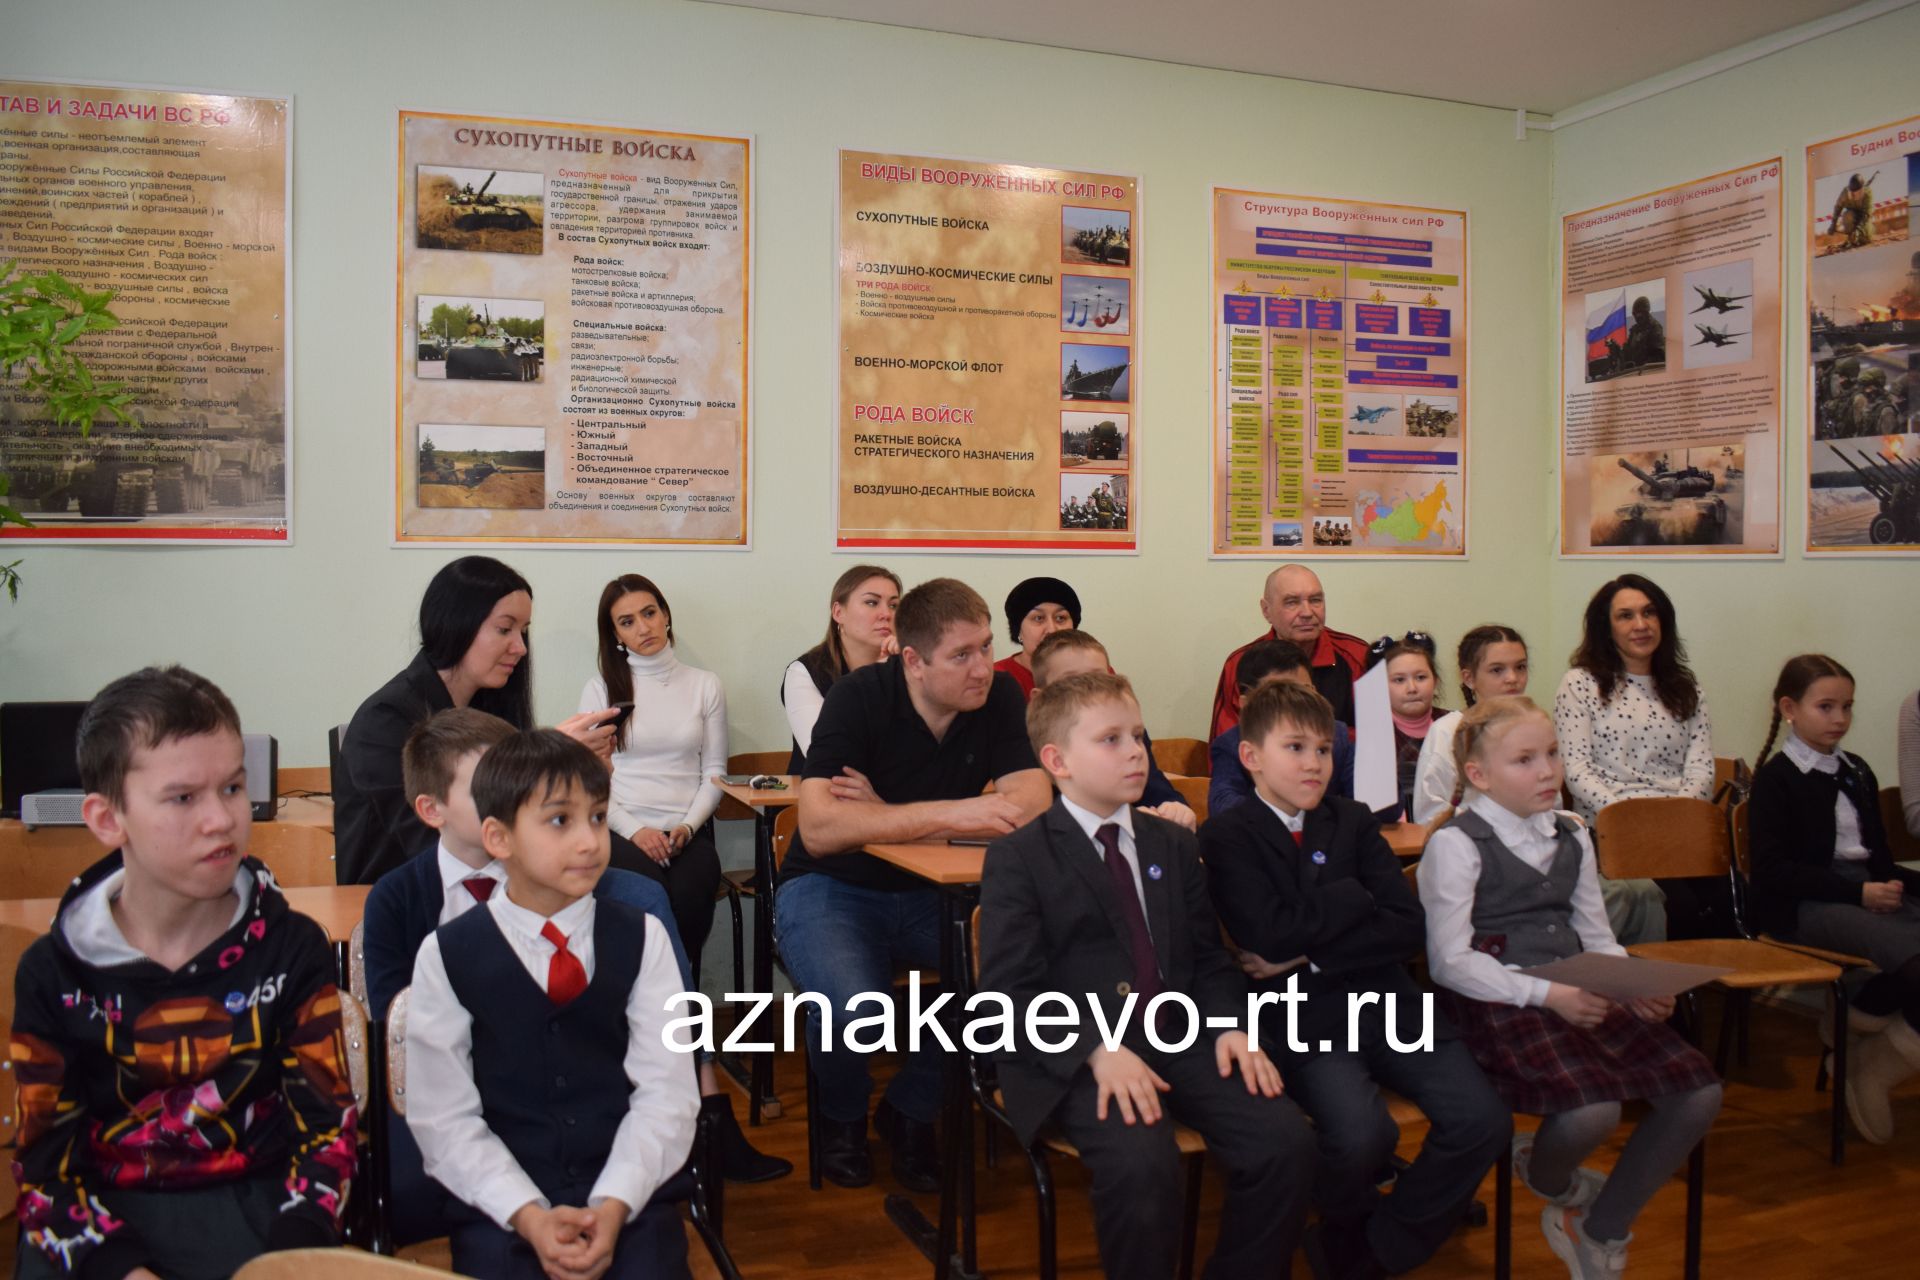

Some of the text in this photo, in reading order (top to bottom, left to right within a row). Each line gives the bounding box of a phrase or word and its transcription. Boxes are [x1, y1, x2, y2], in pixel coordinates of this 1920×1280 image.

[47, 99, 61, 114] И
[69, 100, 157, 120] ЗАДАЧИ
[165, 106, 191, 122] ВС
[200, 108, 230, 125] РФ
[41, 131, 68, 139] силы
[79, 133, 159, 144] неотъемлемый
[163, 138, 207, 147] элемент
[454, 127, 696, 161] СУХОПУТНЫЕ ВОЙСКА
[1850, 137, 1893, 156] Будни
[69, 166, 225, 181] Силы Российской Федерации
[559, 169, 607, 179] Сухопутные
[610, 173, 636, 181] войска
[664, 177, 716, 187] Вооруженных
[720, 181, 737, 189] Сил,
[32, 177, 74, 185] органов
[78, 179, 126, 187] военного
[861, 162, 915, 182] ВИДЫ
[1062, 181, 1095, 197] СИЛ
[1101, 185, 1124, 200] РФ
[551, 180, 630, 191] предназначенный
[693, 191, 737, 199] прикрытия
[92, 191, 188, 202] частей кораблей
[551, 191, 618, 201] государственной
[663, 199, 705, 207] отражения
[710, 202, 737, 210] ударов
[1568, 168, 1777, 232] Предназначение Вооруженных Сил РФ
[551, 202, 737, 220] агрессора, удержания занимаемой
[1244, 201, 1444, 228] Структура Вооруженных сил РФ
[551, 213, 600, 222] территории,
[607, 216, 644, 225] разгрома
[650, 219, 698, 228] группировок
[856, 211, 989, 230] СУХОПУТНЫЕ ВОЙСКА
[26, 221, 213, 238] Сил Российской Федерации входят
[551, 223, 694, 238] овладения территорией противника.
[13, 232, 66, 243] Воздушно
[77, 237, 144, 246] космические
[184, 240, 222, 249] Военно
[233, 244, 274, 252] морской
[598, 235, 649, 246] Сухопутных
[652, 239, 676, 247] войск
[679, 242, 709, 250] входят:
[8, 245, 217, 260] видами Вооружённых Сил Рода войск
[573, 255, 624, 265] Рода войск:
[57, 268, 110, 279] Воздушно
[120, 273, 186, 281] космических
[571, 268, 668, 279] мотострелковые войска;
[856, 262, 1052, 285] ВОЗДУШНО-КОСМИЧЕСКИЕ СИЛЫ
[611, 280, 640, 288] войска;
[856, 280, 872, 288] ТРИ
[875, 281, 899, 291] РОДА
[164, 297, 230, 305] космические
[611, 290, 638, 298] войска
[647, 293, 695, 302] артиллерия;
[860, 290, 887, 299] Военно
[894, 294, 934, 302] воздушные
[571, 299, 724, 313] войсковая противовоздушная оборона.
[860, 299, 886, 308] Войска
[889, 303, 956, 313] противовоздушной
[965, 308, 1024, 316] противоракетной
[1026, 310, 1056, 319] обороны
[860, 309, 907, 319] Космические
[573, 319, 666, 331] Специальные войска:
[146, 329, 217, 339] Федеральной
[571, 333, 648, 342] разведывательные;
[106, 341, 273, 353] пограничной службой Внутрен
[571, 354, 678, 364] радиоэлектронной борьбы;
[854, 357, 1003, 373] ВОЕННО-МОРСКОЙ ФЛОТ
[570, 364, 622, 372] инженерные;
[578, 384, 637, 393] биологической
[571, 395, 642, 404] Организационно
[649, 398, 701, 407] Сухопутные
[854, 404, 973, 423] РОДА ВОЙСК
[577, 419, 645, 429] Центральный
[577, 442, 627, 450] Западный
[854, 434, 961, 446] РАКЕТНЫЕ ВОЙСКА
[577, 453, 633, 461] Восточный
[854, 446, 1033, 460] СТРАТЕГИЧЕСКОГО НАЗНАЧЕНИЯ
[576, 465, 651, 473] Объединенное
[556, 491, 587, 500] Основу
[853, 485, 1035, 496] ВОЗДУШНО-ДЕСАНТНЫЕ ВОЙСКА
[548, 502, 601, 511] объединения
[612, 504, 657, 512] соединения
[660, 504, 706, 513] Сухопутных
